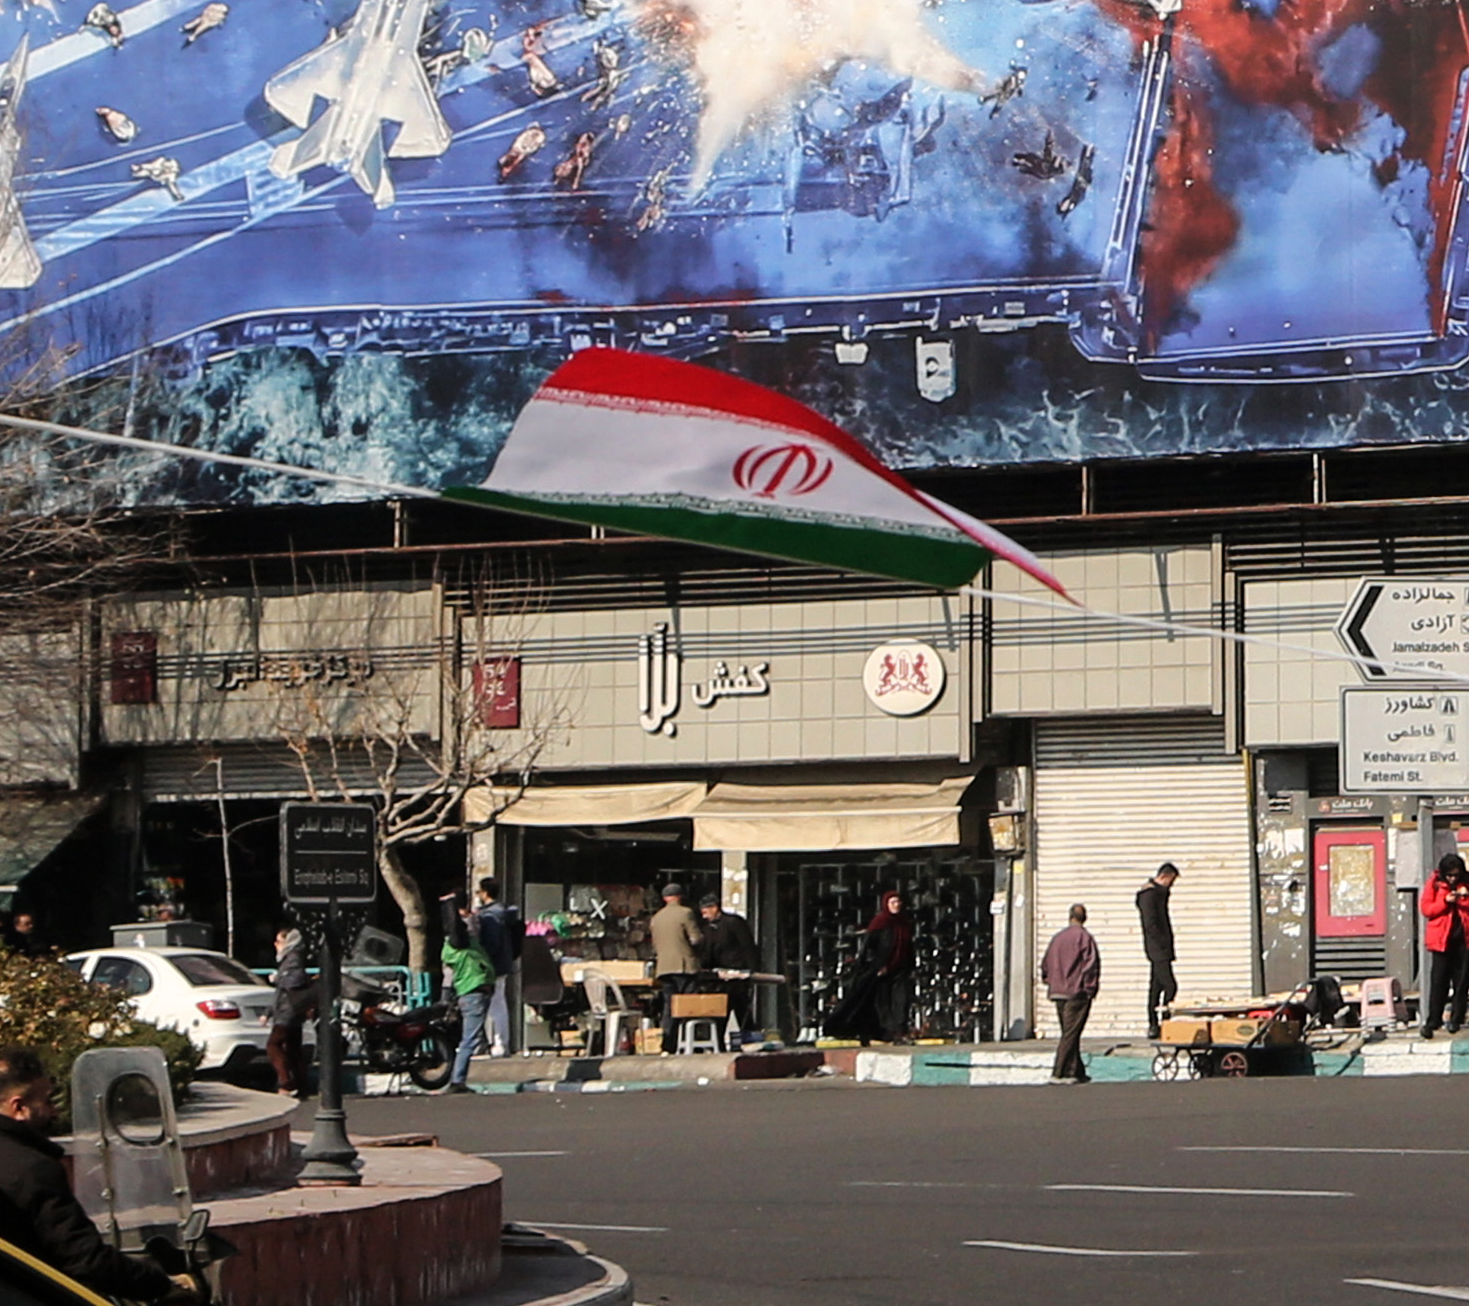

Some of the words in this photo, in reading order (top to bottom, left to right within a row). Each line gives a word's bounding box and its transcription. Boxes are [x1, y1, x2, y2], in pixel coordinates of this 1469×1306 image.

[1392, 587, 1456, 604] جمالزاده
[1411, 614, 1456, 634] آزادی
[1392, 641, 1460, 653] Jamalzadeh
[691, 661, 769, 706] کفش
[1384, 696, 1435, 714] کشاورز
[1387, 724, 1435, 742] فاطمی
[1363, 751, 1426, 763] Keshavarz
[1430, 751, 1459, 763] Blvd.
[1364, 771, 1404, 782] Fatemi
[1407, 771, 1423, 782] St.
